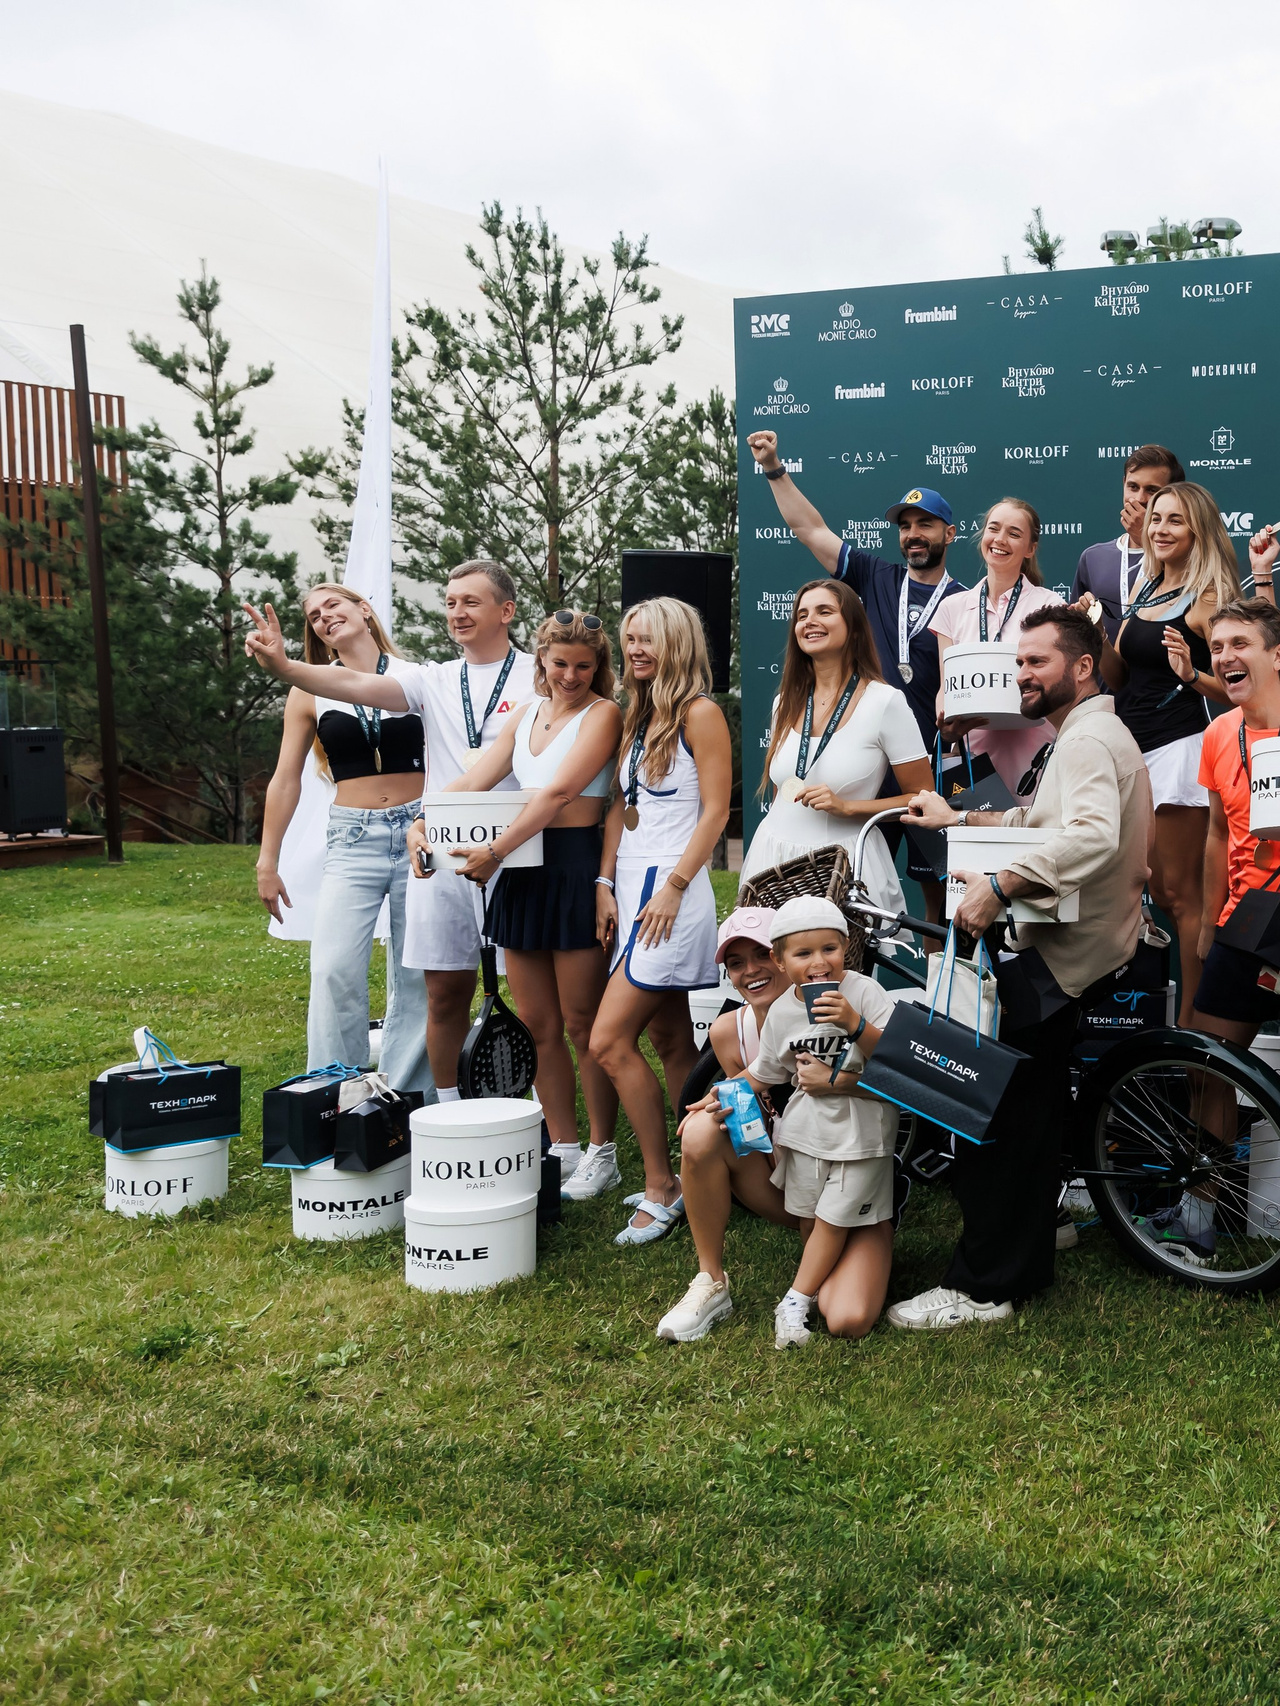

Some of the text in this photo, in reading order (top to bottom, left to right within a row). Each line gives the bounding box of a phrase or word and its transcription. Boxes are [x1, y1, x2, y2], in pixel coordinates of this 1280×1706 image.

[1101, 282, 1149, 297] Внуково
[1183, 282, 1252, 297] KORLOFF
[1001, 295, 1048, 310] CASA
[1094, 294, 1138, 307] Кантри
[905, 305, 956, 323] frambini
[1111, 304, 1140, 317] Клуб
[833, 319, 860, 330] RADIO
[818, 326, 876, 341] MONTE CARLO
[1008, 364, 1055, 379] Внуково
[1098, 363, 1147, 376] CASA
[1192, 363, 1256, 377] МОСКВИЧКА
[912, 376, 973, 392] KORLOFF
[1002, 377, 1043, 389] Кантри
[835, 383, 885, 399] frambini
[1018, 387, 1046, 397] Клуб
[768, 394, 794, 404] RADIO
[754, 402, 809, 415] MONTE CARLO
[932, 442, 976, 457] Внуково
[1005, 446, 1069, 461] KORLOFF
[1099, 445, 1159, 458] МОСКВ
[842, 452, 885, 465] CASA
[926, 455, 965, 467] Кантри
[1189, 458, 1252, 466] MONTALE
[755, 458, 802, 474] frbini
[942, 465, 968, 475] Клуб
[848, 518, 890, 532] Внуково
[1220, 512, 1253, 531] MC
[756, 528, 797, 539] KORL
[1040, 523, 1082, 534] СКВИЧКА
[842, 530, 880, 541] Кантри
[858, 539, 882, 549] Клуб
[762, 590, 797, 602] Внуко
[945, 673, 1012, 694] ORLOFF
[429, 826, 510, 843] ORLOF
[1087, 1017, 1144, 1025] ТЕХНОПАРК
[910, 1040, 979, 1081] ТЕХНОПАРК
[150, 1094, 217, 1109] ТЕХНОПАРК
[422, 1148, 536, 1181] KORLOFF
[106, 1176, 194, 1197] ORLOFF
[466, 1181, 495, 1189] PARIS
[121, 1198, 145, 1206] PARIS
[298, 1189, 405, 1213] MONTALE
[328, 1209, 382, 1221] PARIS
[406, 1246, 489, 1262] ONTALE
[411, 1260, 455, 1270] PARIS
